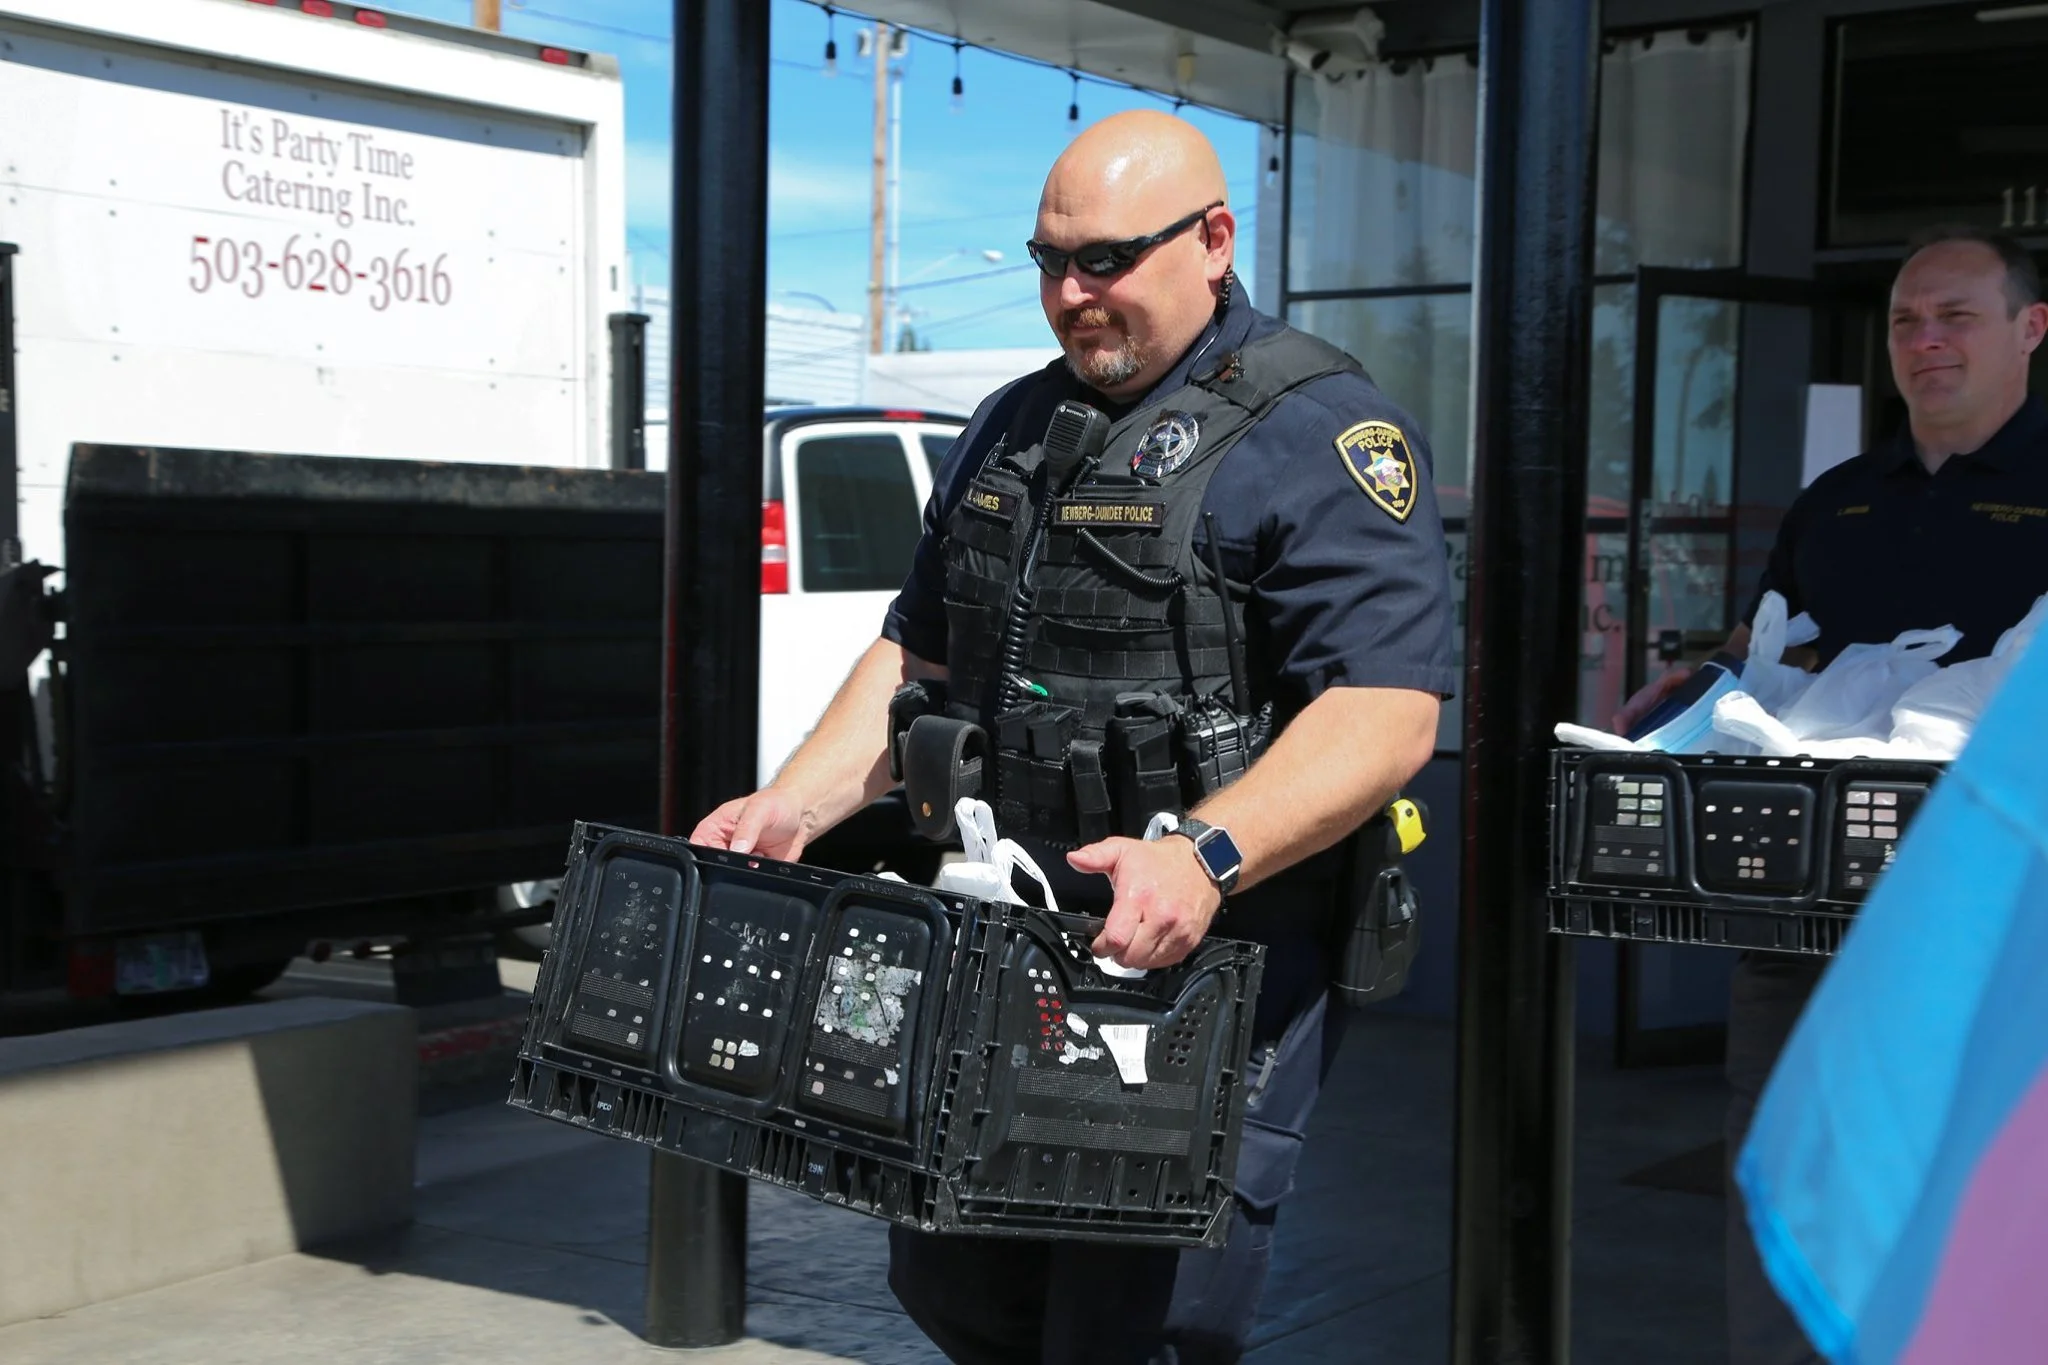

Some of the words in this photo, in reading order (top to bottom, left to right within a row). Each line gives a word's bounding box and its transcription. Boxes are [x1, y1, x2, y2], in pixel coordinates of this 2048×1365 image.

[220, 108, 264, 154] It's
[271, 118, 342, 177] Party
[347, 132, 414, 180] Time
[222, 159, 354, 229] Catering
[362, 181, 416, 227] Inc.
[1999, 184, 2048, 229] 11
[189, 233, 452, 311] 503-628-3616
[1357, 435, 1394, 452] POLICE
[1061, 505, 1123, 522] NEWBERG-DUNDEE
[1124, 506, 1154, 522] POLICE
[1990, 512, 2023, 523] POLICE
[597, 1100, 612, 1112] IFCO
